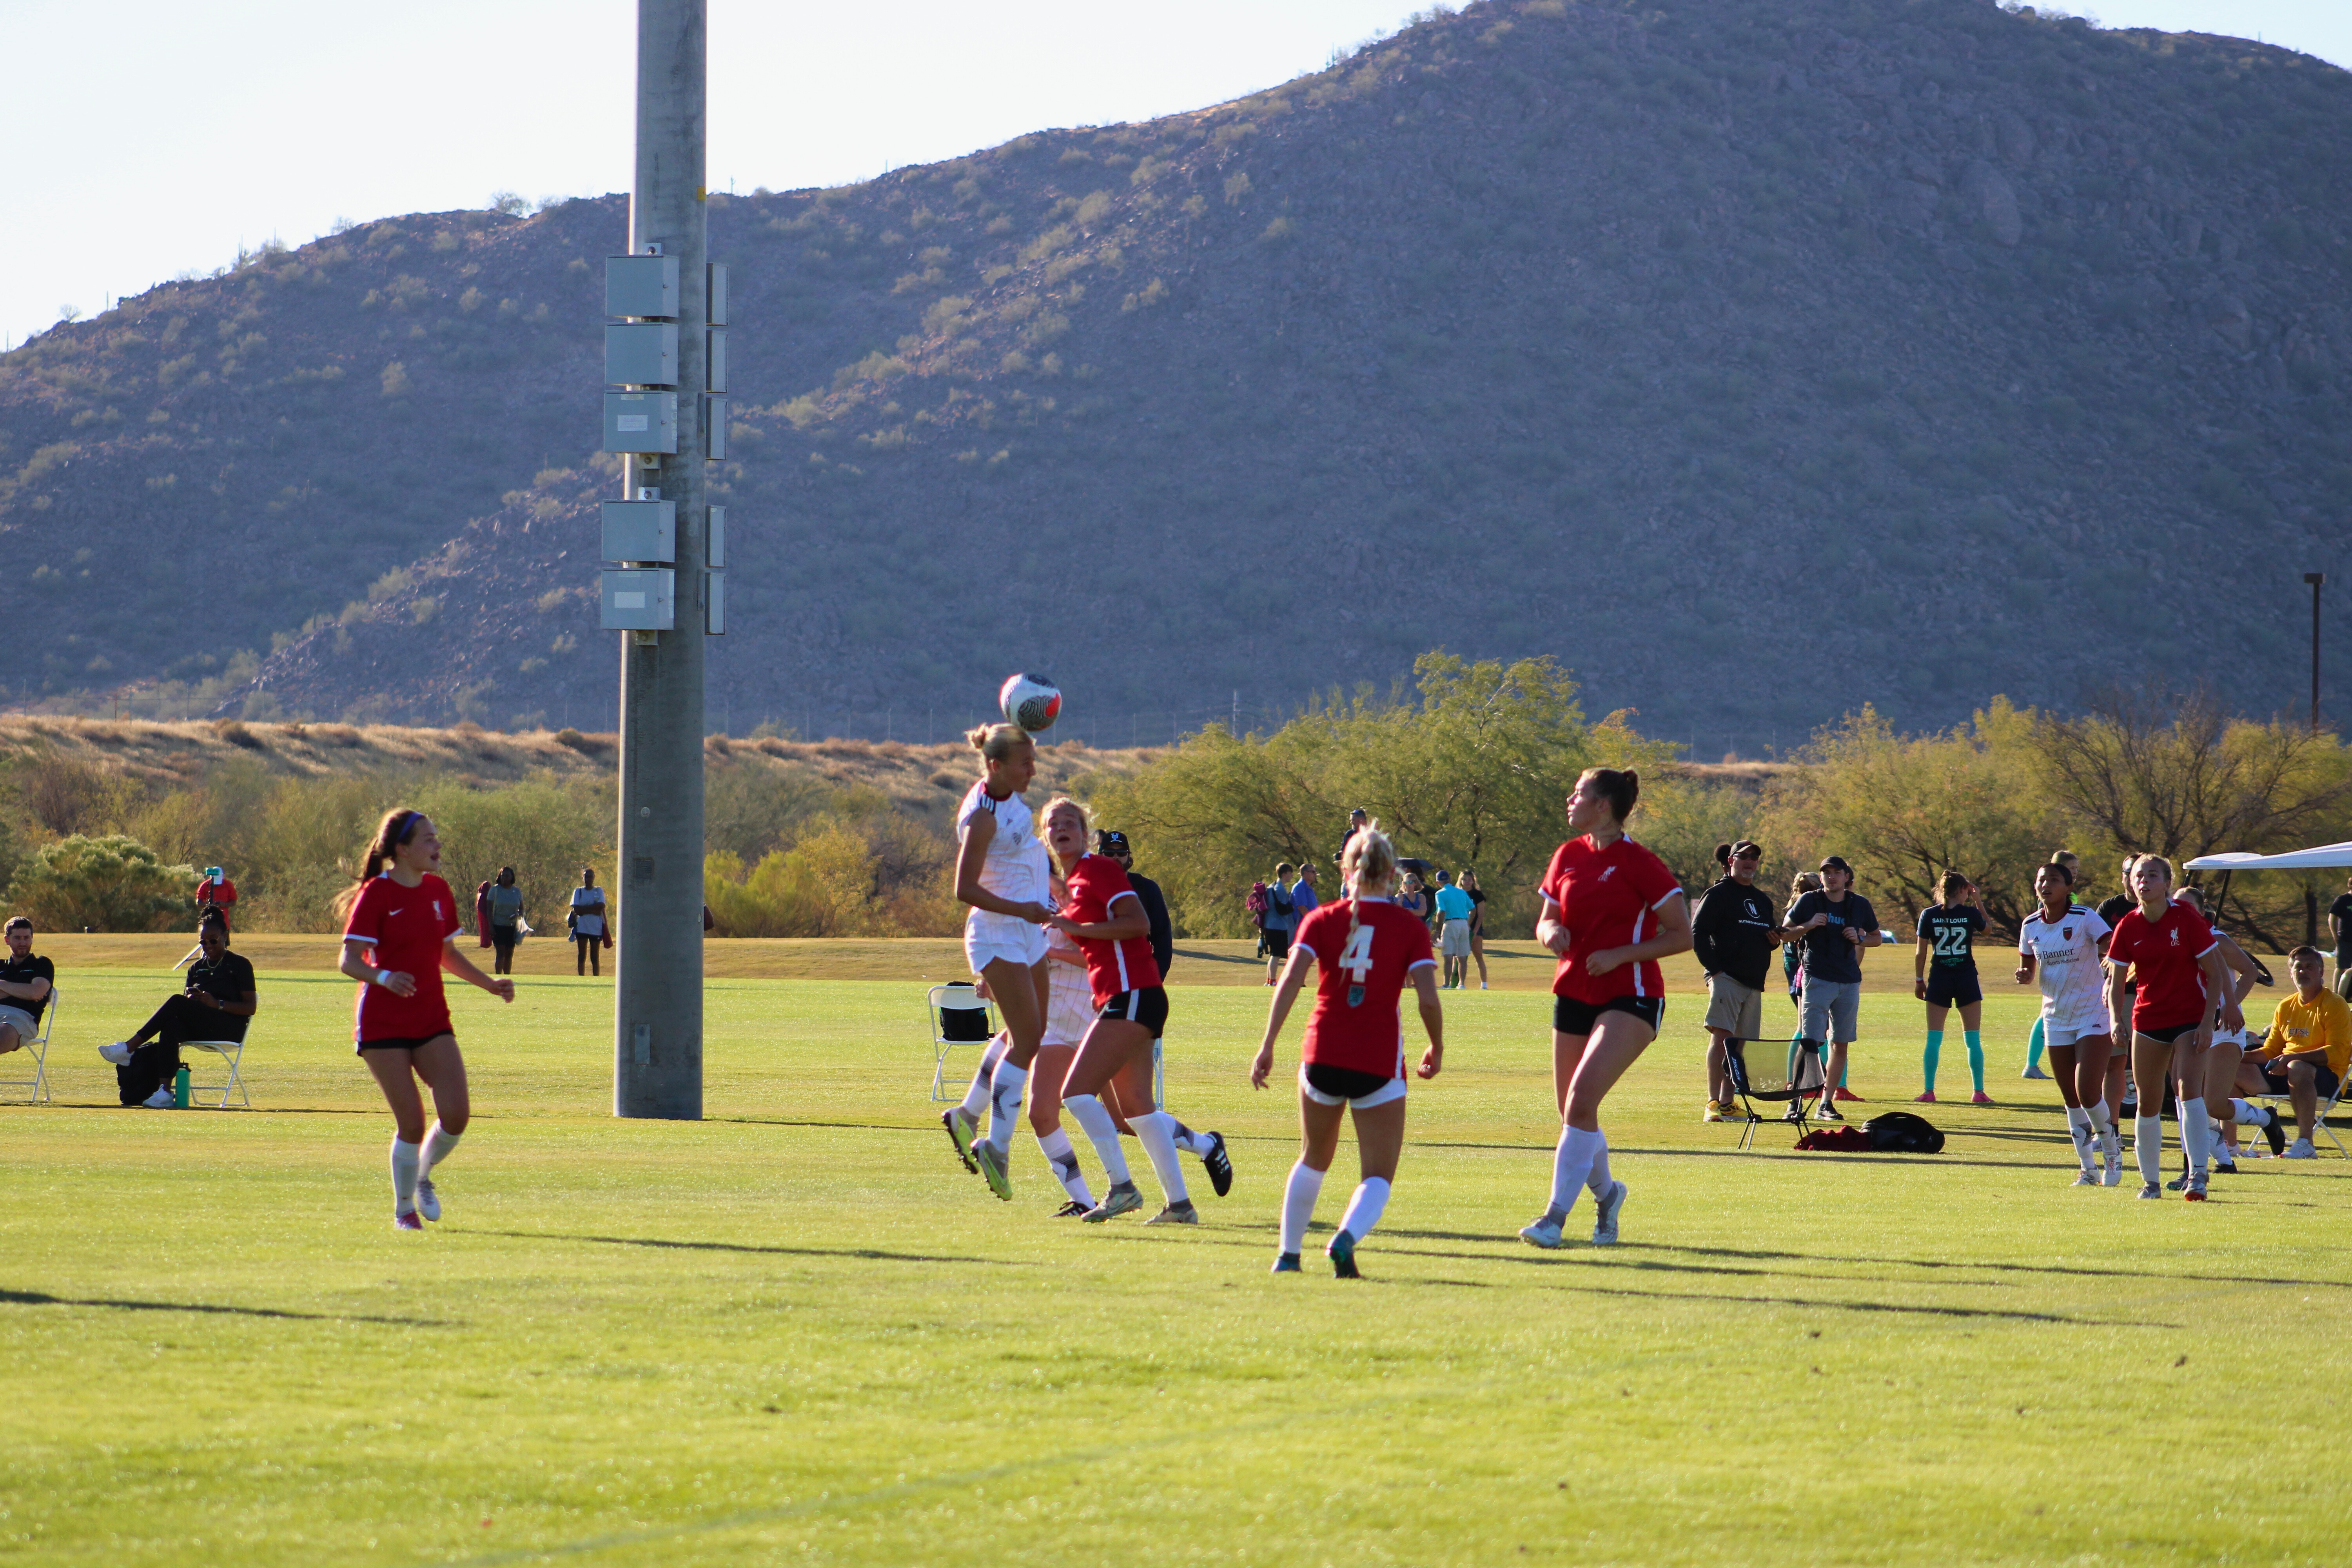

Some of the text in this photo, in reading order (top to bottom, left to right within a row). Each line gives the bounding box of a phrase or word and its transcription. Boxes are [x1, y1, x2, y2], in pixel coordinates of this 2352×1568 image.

[1748, 903, 1757, 915] N
[1338, 924, 1375, 983] 4
[1934, 927, 1967, 955] 22
